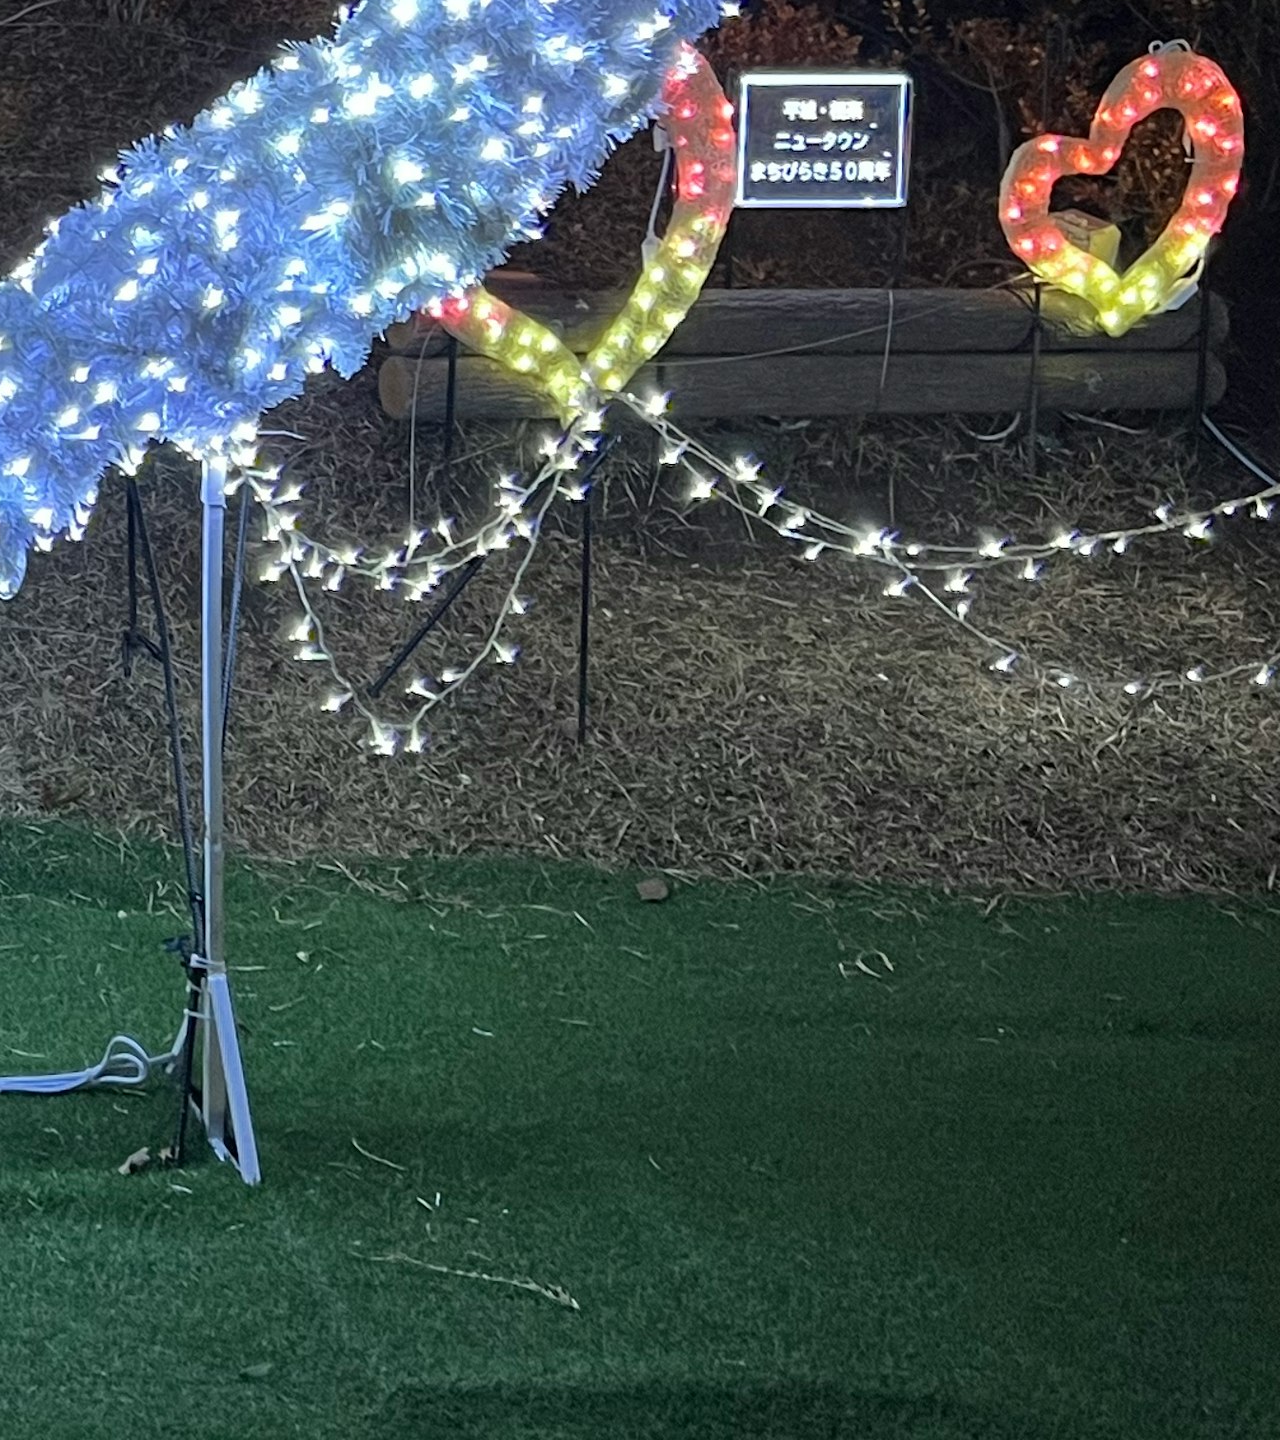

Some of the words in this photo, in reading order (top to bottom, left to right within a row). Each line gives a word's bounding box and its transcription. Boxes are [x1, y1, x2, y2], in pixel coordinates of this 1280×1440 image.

[773, 131, 870, 152] ニュータウン
[750, 160, 891, 183] まちびらき50周年
